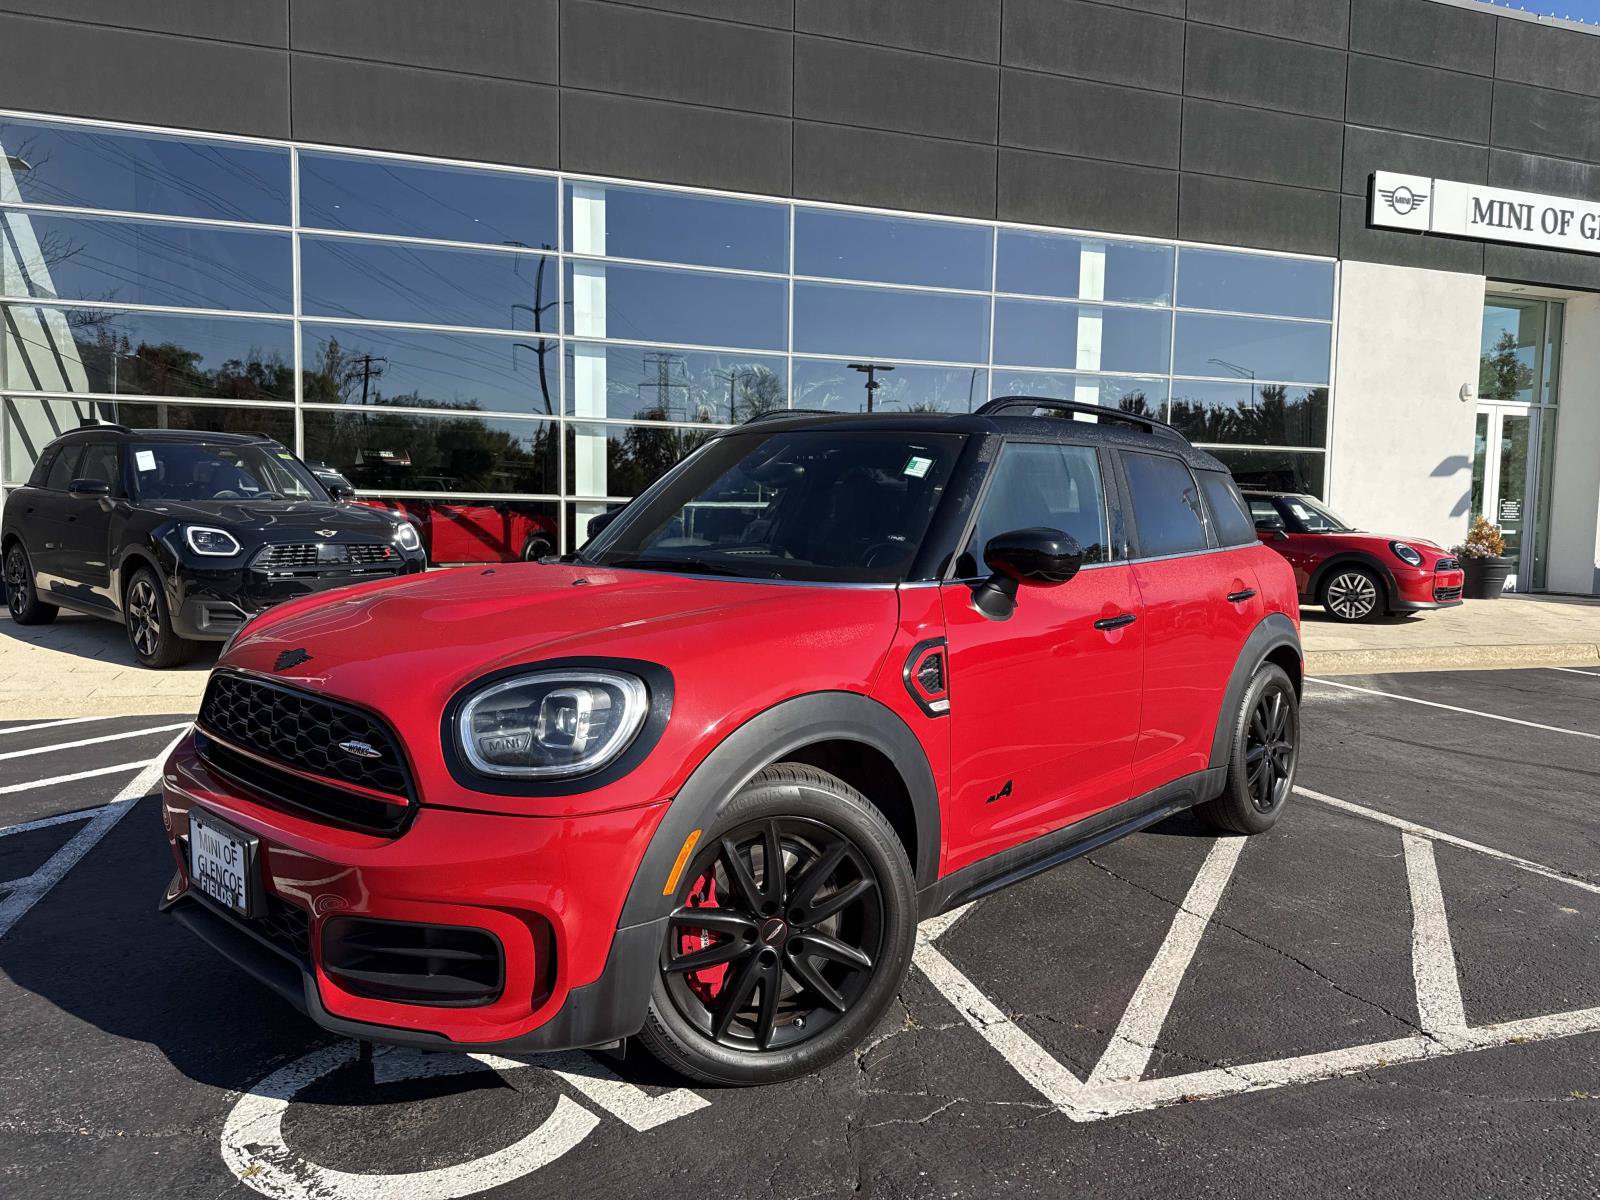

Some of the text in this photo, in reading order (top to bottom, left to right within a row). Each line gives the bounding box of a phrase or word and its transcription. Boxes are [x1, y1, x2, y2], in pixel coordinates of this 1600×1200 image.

[1395, 195, 1411, 205] MINI
[1471, 197, 1535, 231] MINI
[1541, 207, 1574, 236] OF
[489, 738, 520, 751] MINI
[199, 830, 238, 867] MINI OF
[197, 855, 244, 897] GLENCOE
[201, 877, 233, 909] FIELDS
